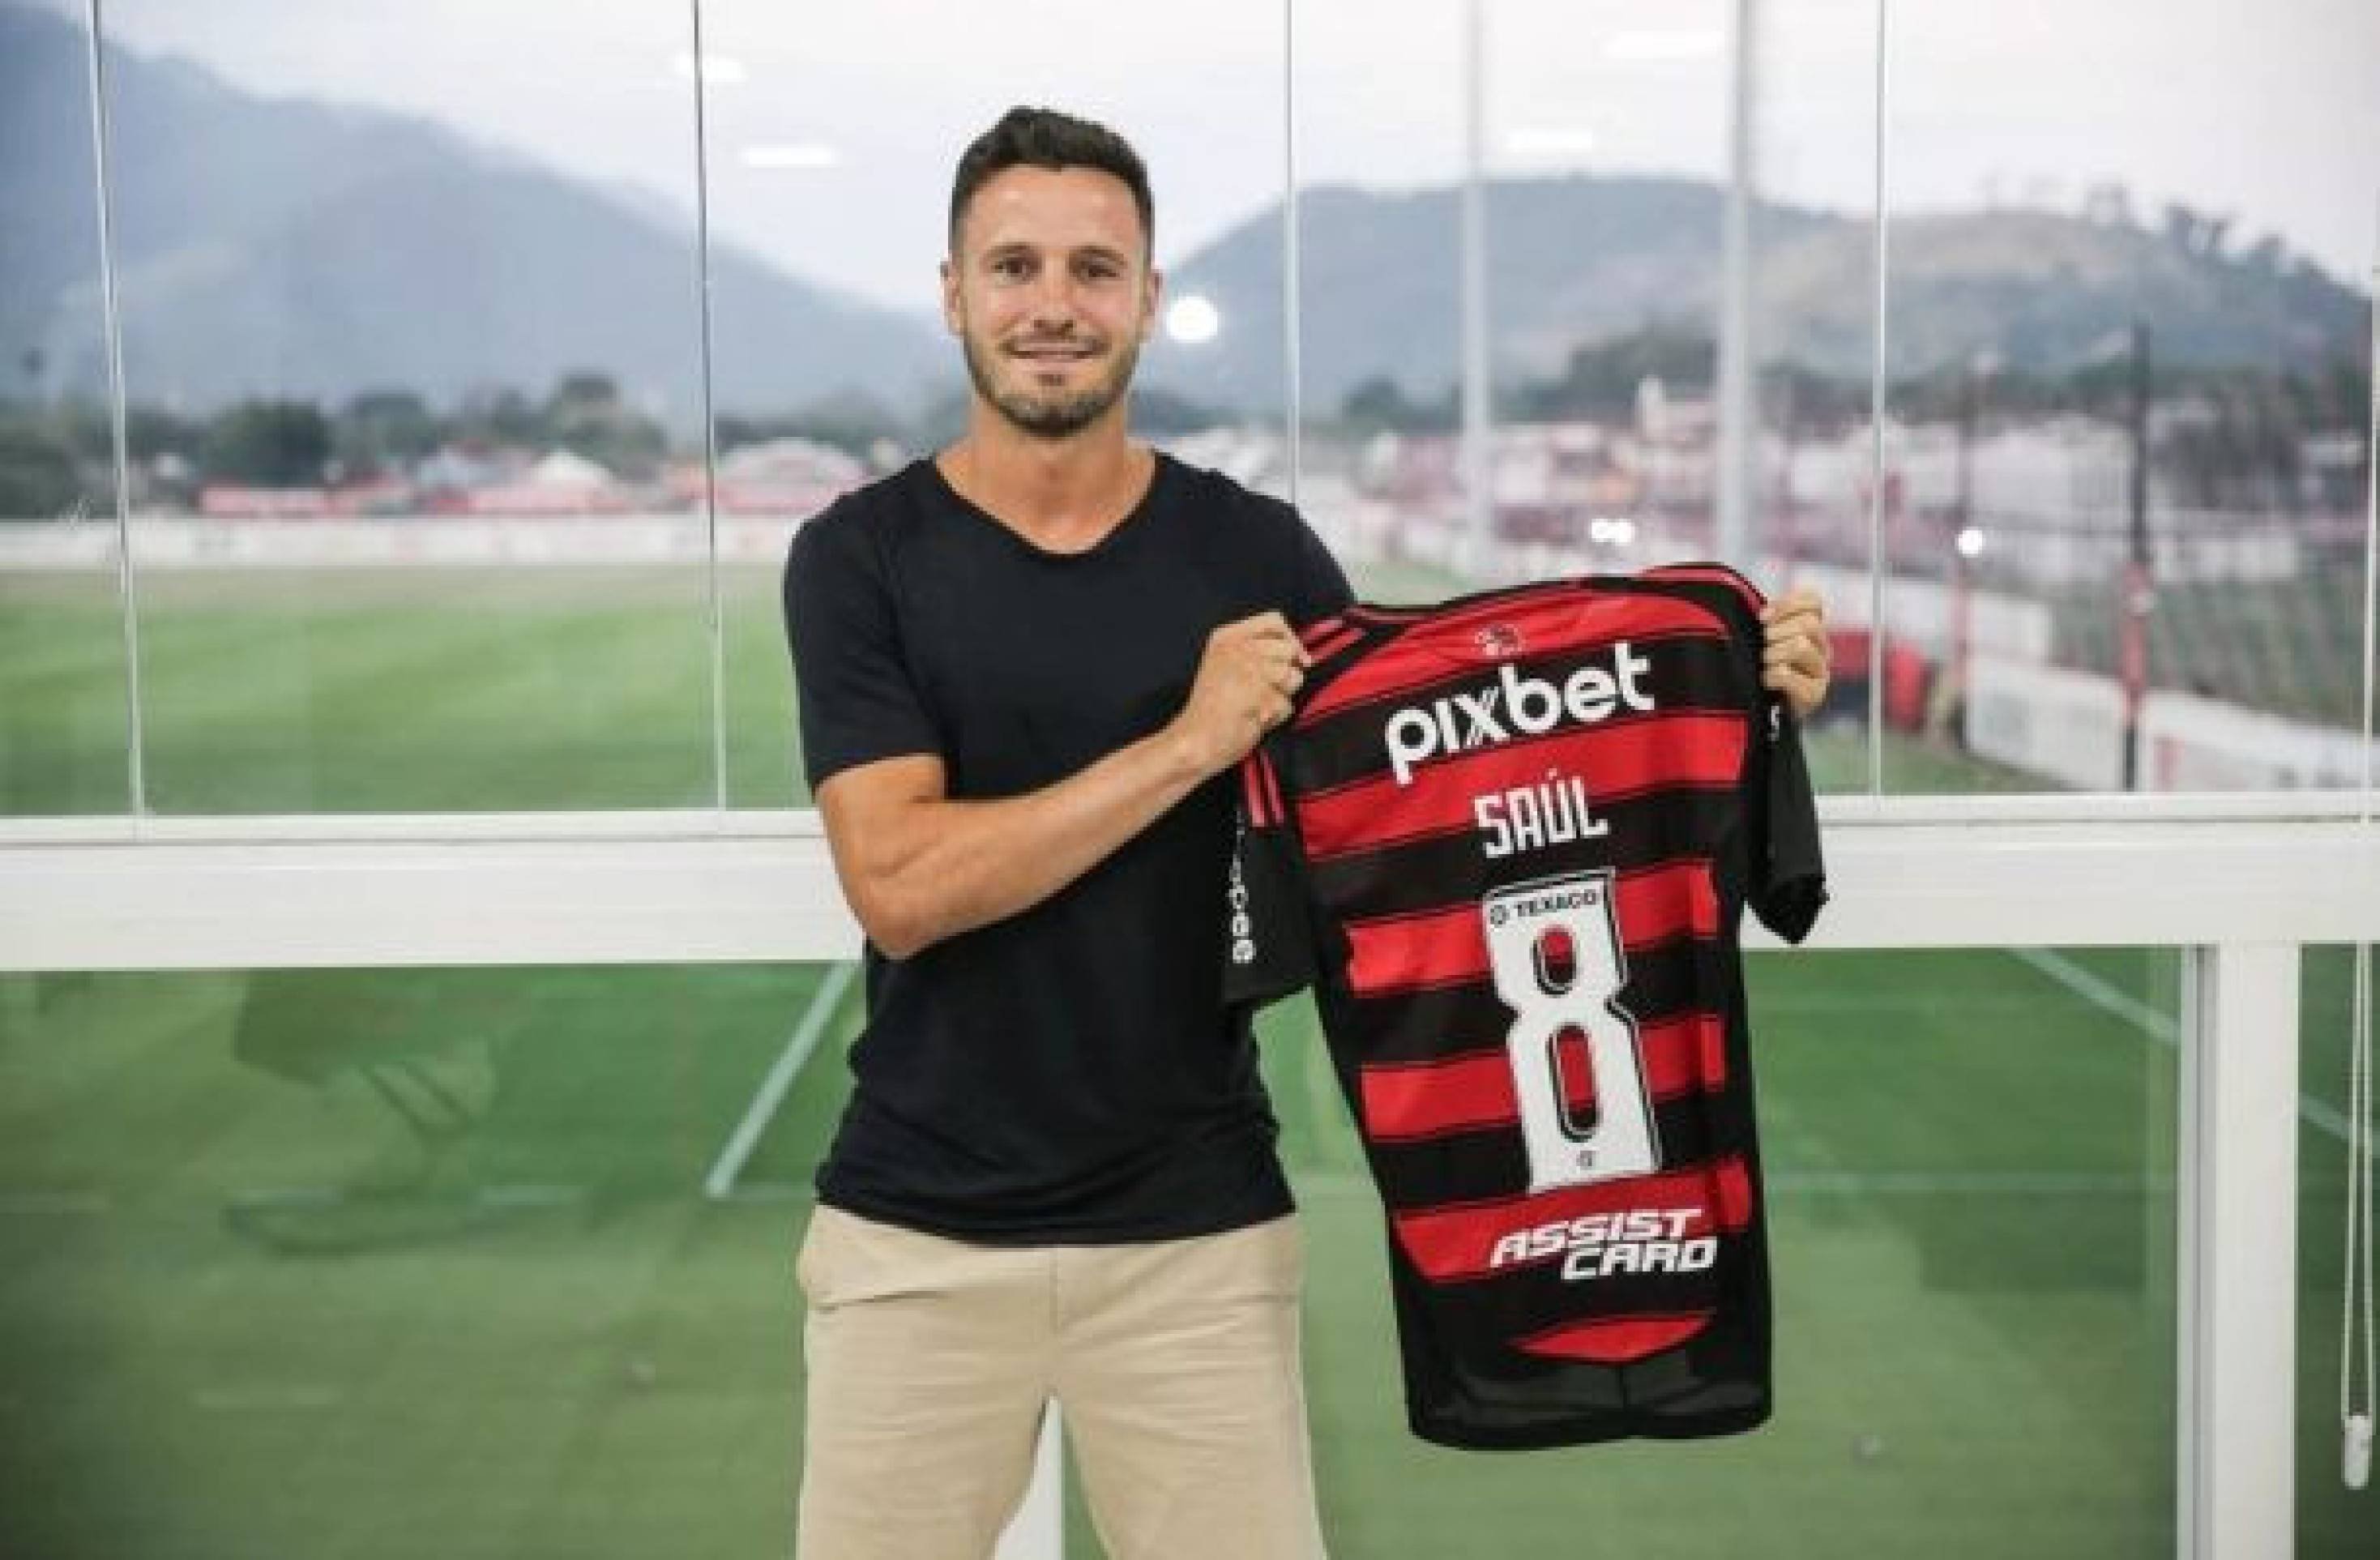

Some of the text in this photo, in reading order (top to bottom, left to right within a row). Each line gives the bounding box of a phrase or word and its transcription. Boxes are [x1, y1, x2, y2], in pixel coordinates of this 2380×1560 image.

[1386, 641, 1655, 785] pixbet
[1473, 770, 1609, 857] SAÚL
[1515, 888, 1598, 917] TEXACO
[1483, 868, 1660, 1195] 8
[1489, 1208, 1703, 1267] ASSIST
[1561, 1236, 1717, 1280] CARD
